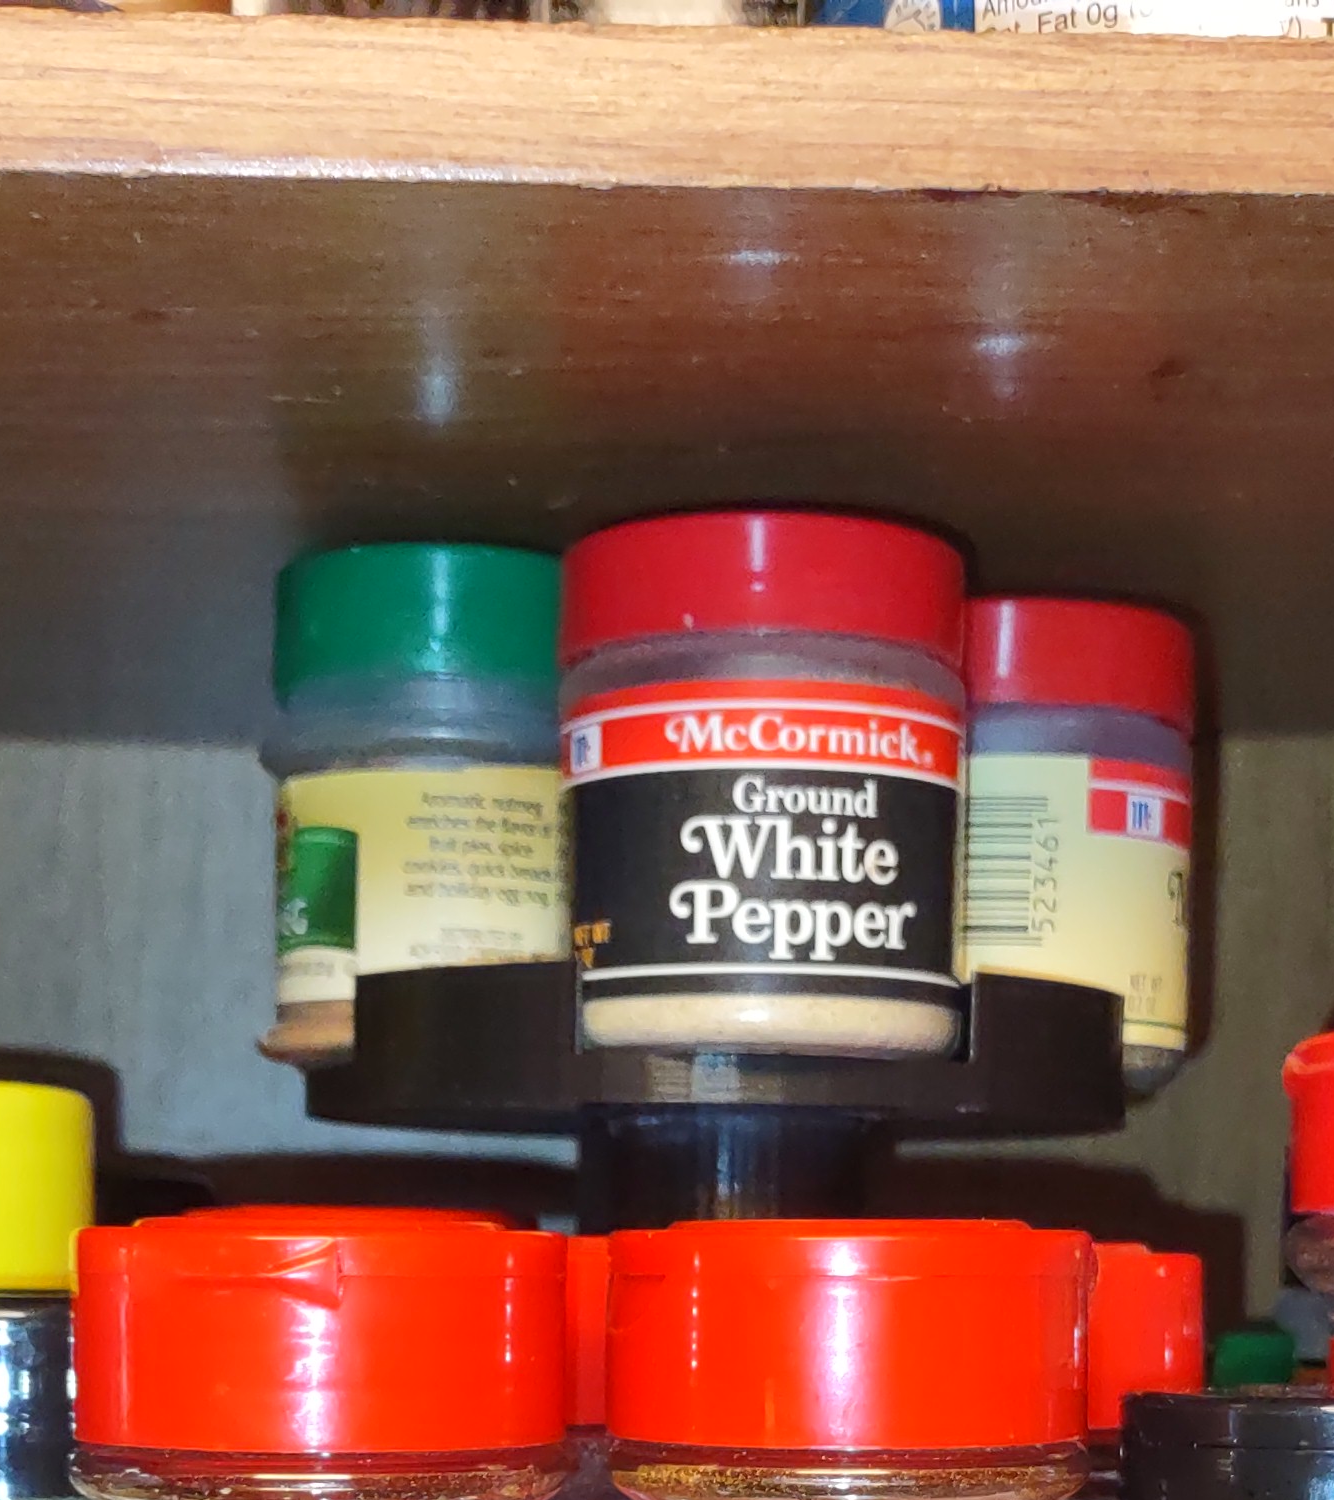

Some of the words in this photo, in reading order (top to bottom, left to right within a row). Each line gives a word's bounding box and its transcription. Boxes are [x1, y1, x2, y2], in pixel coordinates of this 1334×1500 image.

[665, 712, 924, 765] McCormick
[732, 774, 879, 819] Ground
[680, 814, 899, 886] White
[669, 879, 917, 961] Pepper
